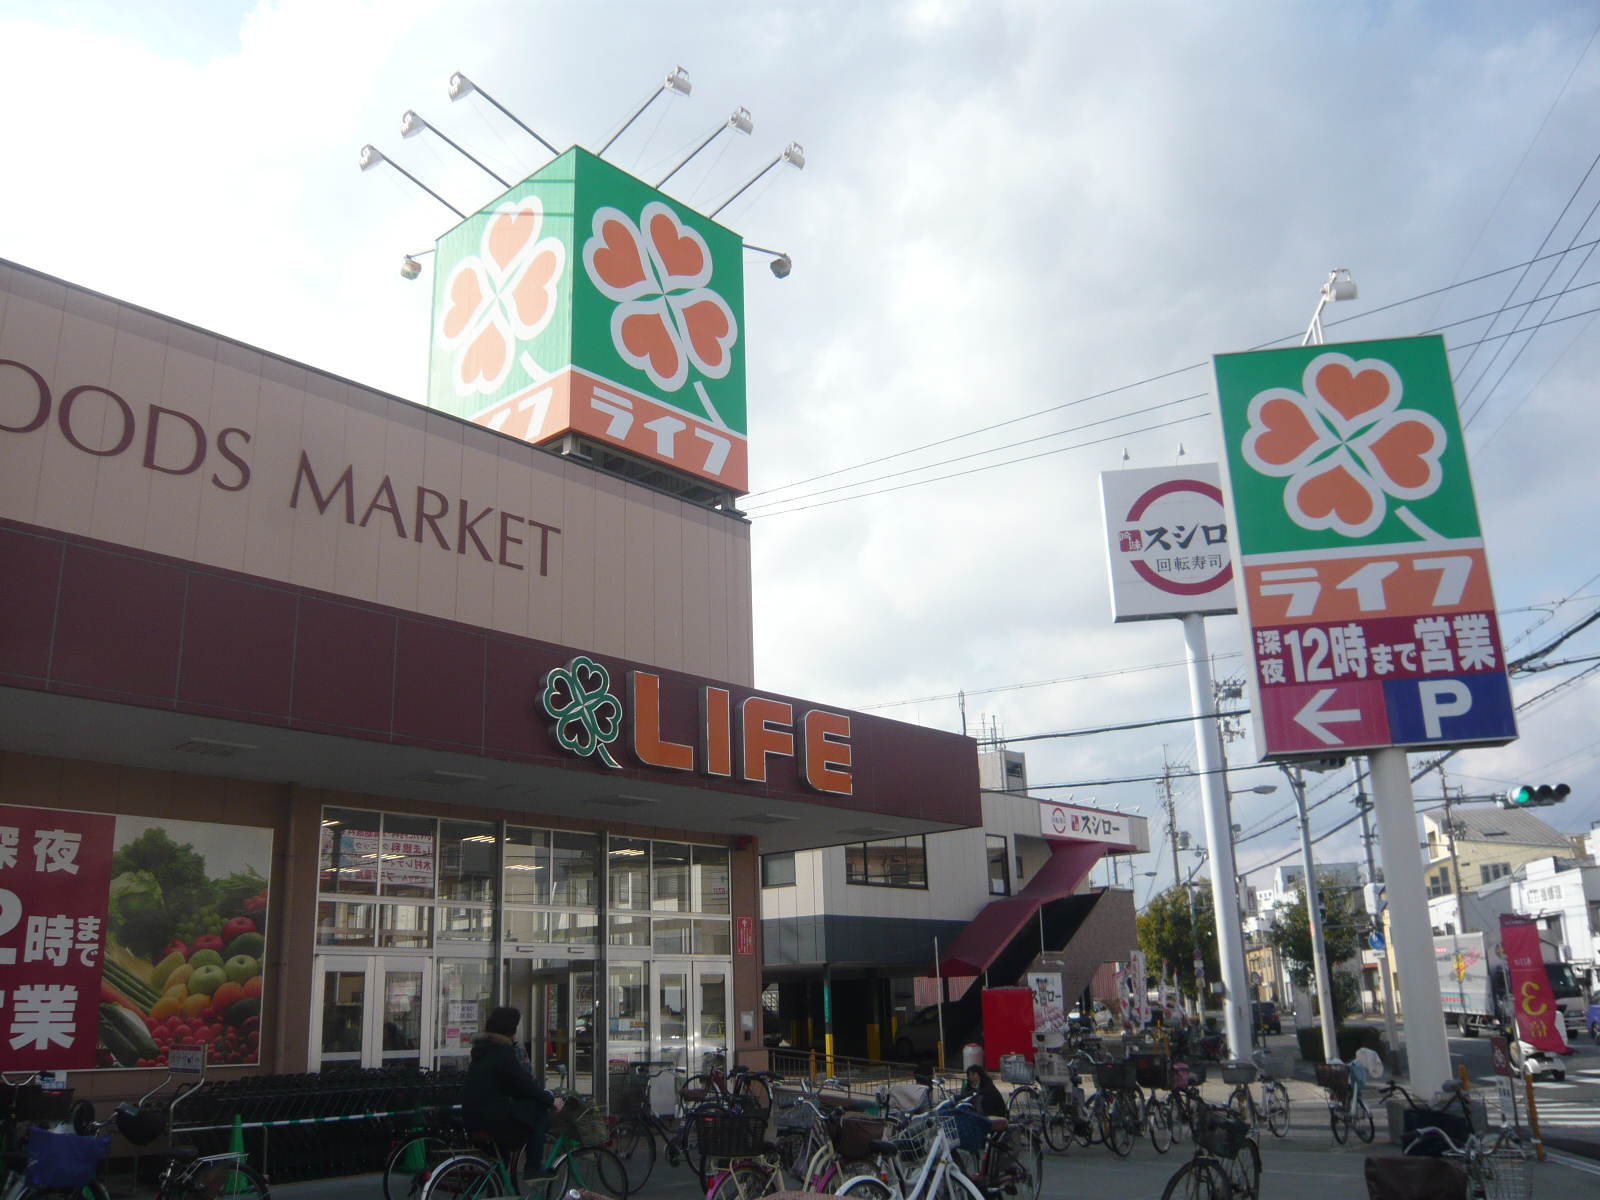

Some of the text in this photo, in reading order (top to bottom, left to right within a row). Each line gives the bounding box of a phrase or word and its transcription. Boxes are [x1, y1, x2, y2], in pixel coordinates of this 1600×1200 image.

[590, 385, 732, 476] ライフ
[289, 449, 562, 577] MARKET
[1156, 553, 1223, 573] 回転寿司
[1259, 555, 1473, 618] ライフ
[628, 670, 853, 795] LIFE
[1418, 680, 1473, 739] P
[1081, 815, 1121, 836] スシロー
